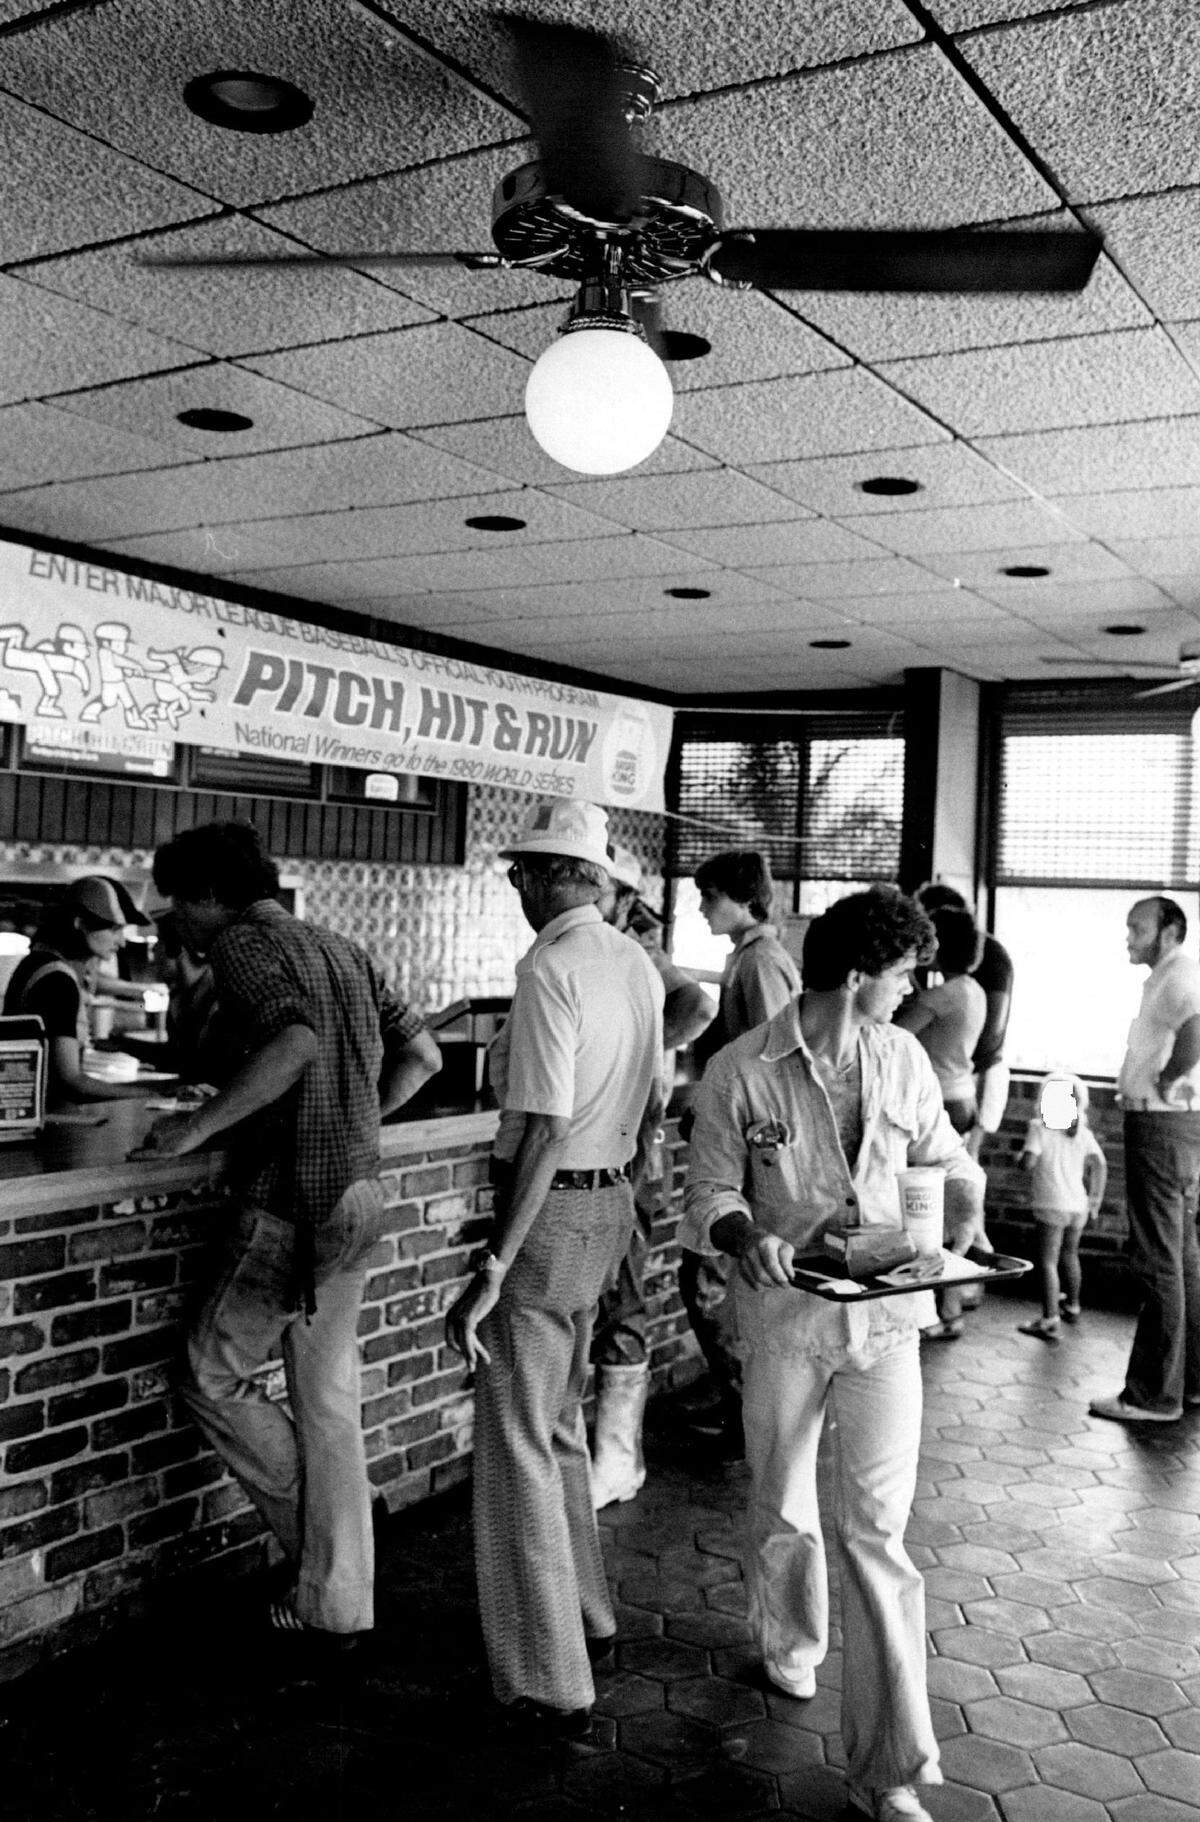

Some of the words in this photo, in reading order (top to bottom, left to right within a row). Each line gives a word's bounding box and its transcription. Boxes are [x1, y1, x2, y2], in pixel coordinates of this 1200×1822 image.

[29, 550, 120, 596] ENTER
[125, 574, 212, 618] MAJOR
[212, 597, 299, 640] LEAGUE
[410, 649, 485, 685] OFFICIAL
[233, 650, 412, 745] PITCH,
[417, 685, 488, 746] HIT
[493, 702, 522, 752] &
[524, 710, 598, 764] RUN
[235, 721, 312, 754] National
[315, 735, 383, 764] Winners
[383, 752, 405, 772] go
[406, 746, 422, 771] to
[422, 754, 448, 773] the
[448, 758, 484, 779] 1980
[484, 763, 533, 788] WORLD
[532, 769, 577, 796] SERIES
